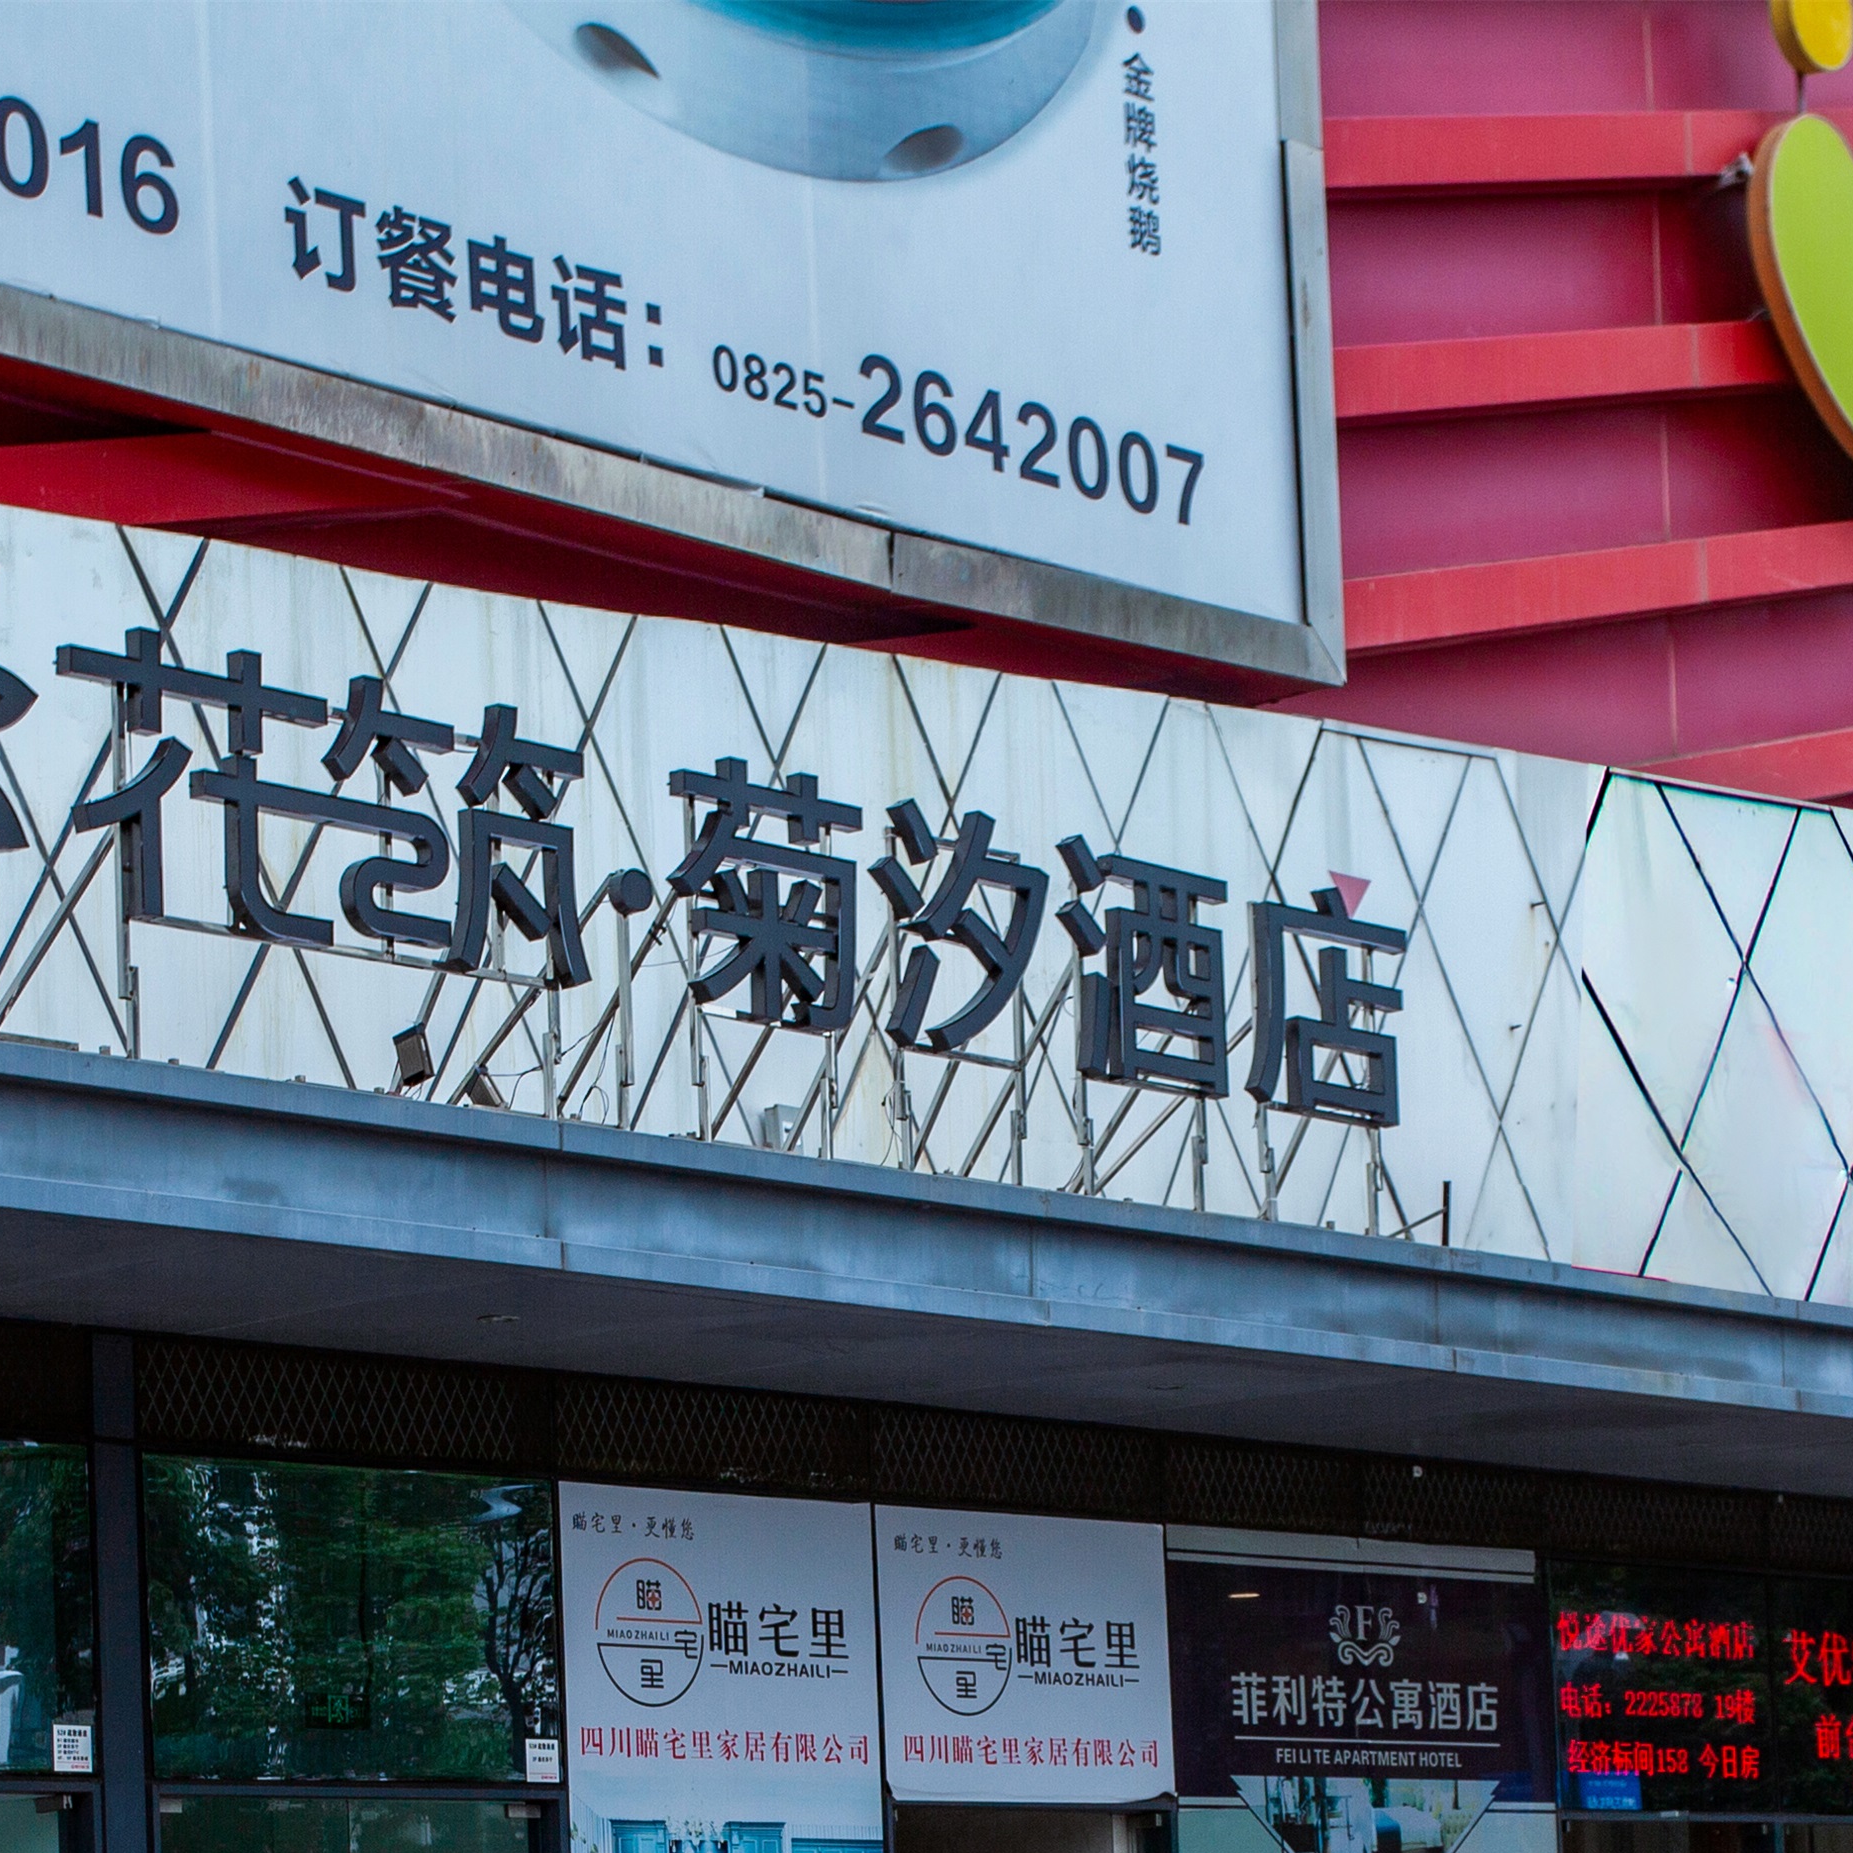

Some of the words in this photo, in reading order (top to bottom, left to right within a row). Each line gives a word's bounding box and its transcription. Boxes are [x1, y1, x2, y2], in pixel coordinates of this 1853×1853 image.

[1122, 52, 1161, 257] 金牌烧鹅
[712, 344, 1205, 527] 0825-2642007
[606, 1628, 670, 1641] MIAOZHAILI
[707, 1601, 849, 1660] 瞄宅里
[1014, 1616, 1140, 1669] 瞄宅里
[925, 1642, 982, 1655] MIAOZHAILI
[728, 1663, 832, 1680] MIAOZHAILI
[1033, 1671, 1126, 1688] MIAOZHAILI
[1232, 1672, 1499, 1732] 菲利特公寓酒店
[1624, 1690, 1704, 1719] 2225878
[579, 1725, 870, 1767] 四川瞄宅里家居有限公司
[902, 1734, 1160, 1769] 四川瞄宅里家居有限公司
[1334, 1750, 1417, 1767] APARTMENT
[1419, 1752, 1462, 1768] HOTEL
